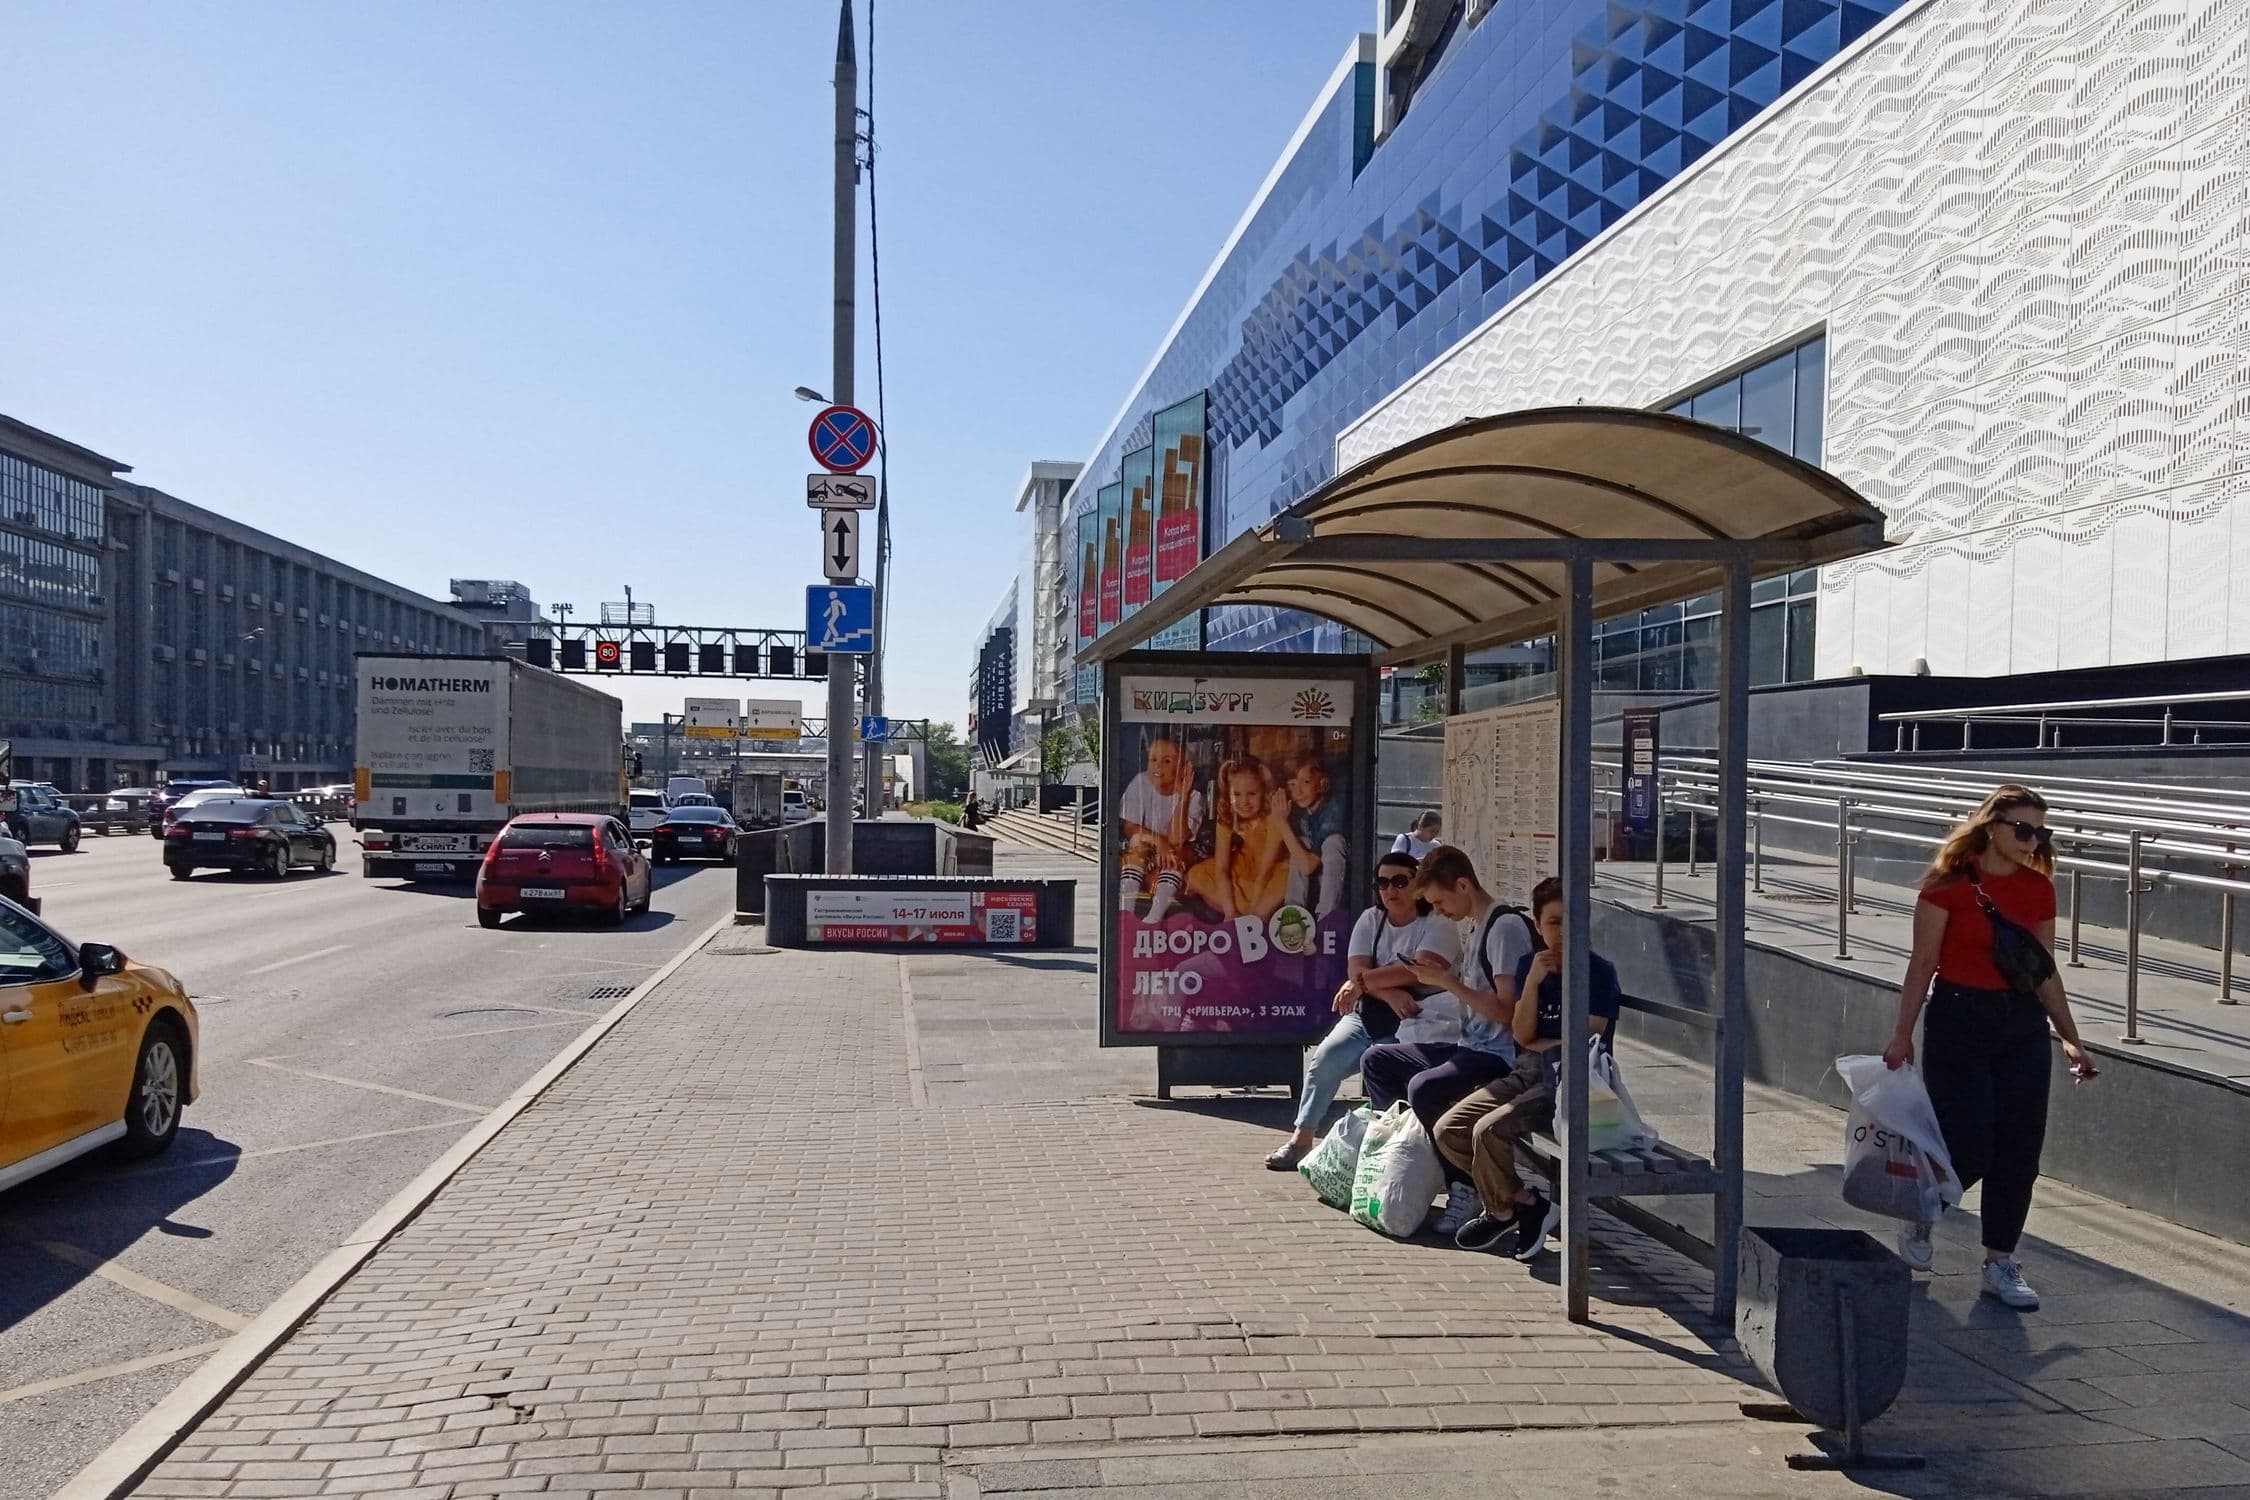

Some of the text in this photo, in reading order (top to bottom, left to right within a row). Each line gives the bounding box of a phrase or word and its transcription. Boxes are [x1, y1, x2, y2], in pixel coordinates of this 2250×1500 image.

[602, 648, 614, 657] 80
[371, 676, 490, 692] HOMATHERM
[997, 652, 1005, 709] РИВЬЕРА
[1133, 681, 1254, 714] КИДБУРГ
[1332, 730, 1346, 741] 0+
[929, 910, 965, 919] июля
[827, 927, 888, 938] ВКУСЫ РОССИИ
[1132, 970, 1203, 996] ЛЕТО
[1161, 1005, 1182, 1018] ТРЦ
[1259, 1006, 1267, 1016] 3
[1271, 1005, 1306, 1017] ЭТАЖ
